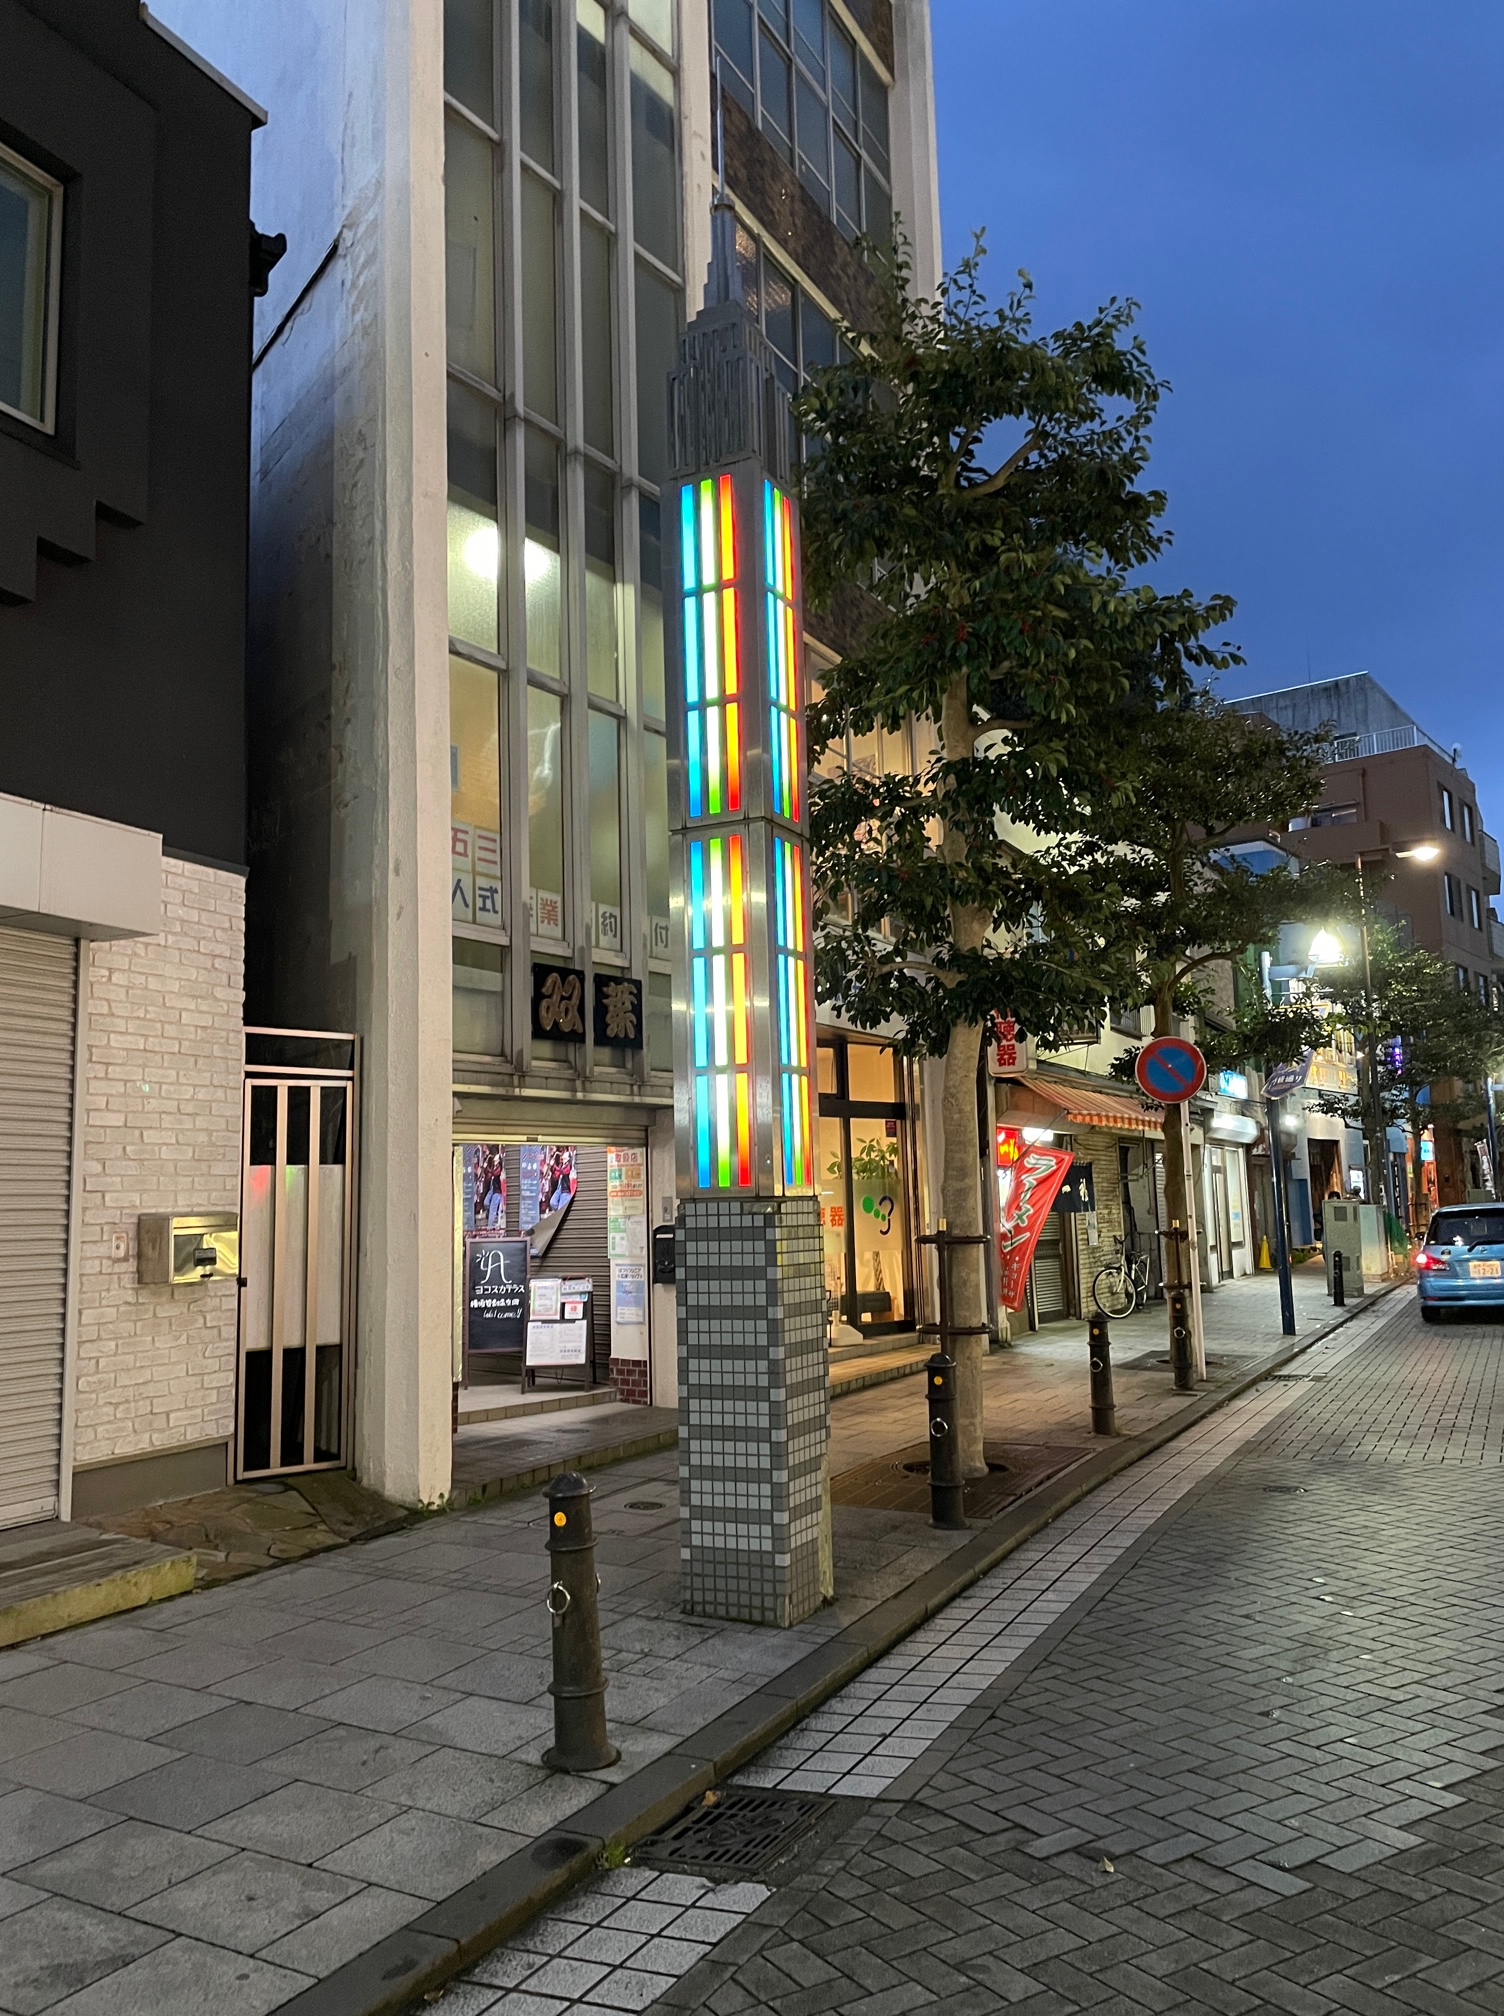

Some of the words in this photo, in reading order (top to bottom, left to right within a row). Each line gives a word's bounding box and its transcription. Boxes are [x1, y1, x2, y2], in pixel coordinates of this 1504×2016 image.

[1001, 1153, 1057, 1253] ラーメン
[474, 1284, 525, 1295] ヨコスカテラス
